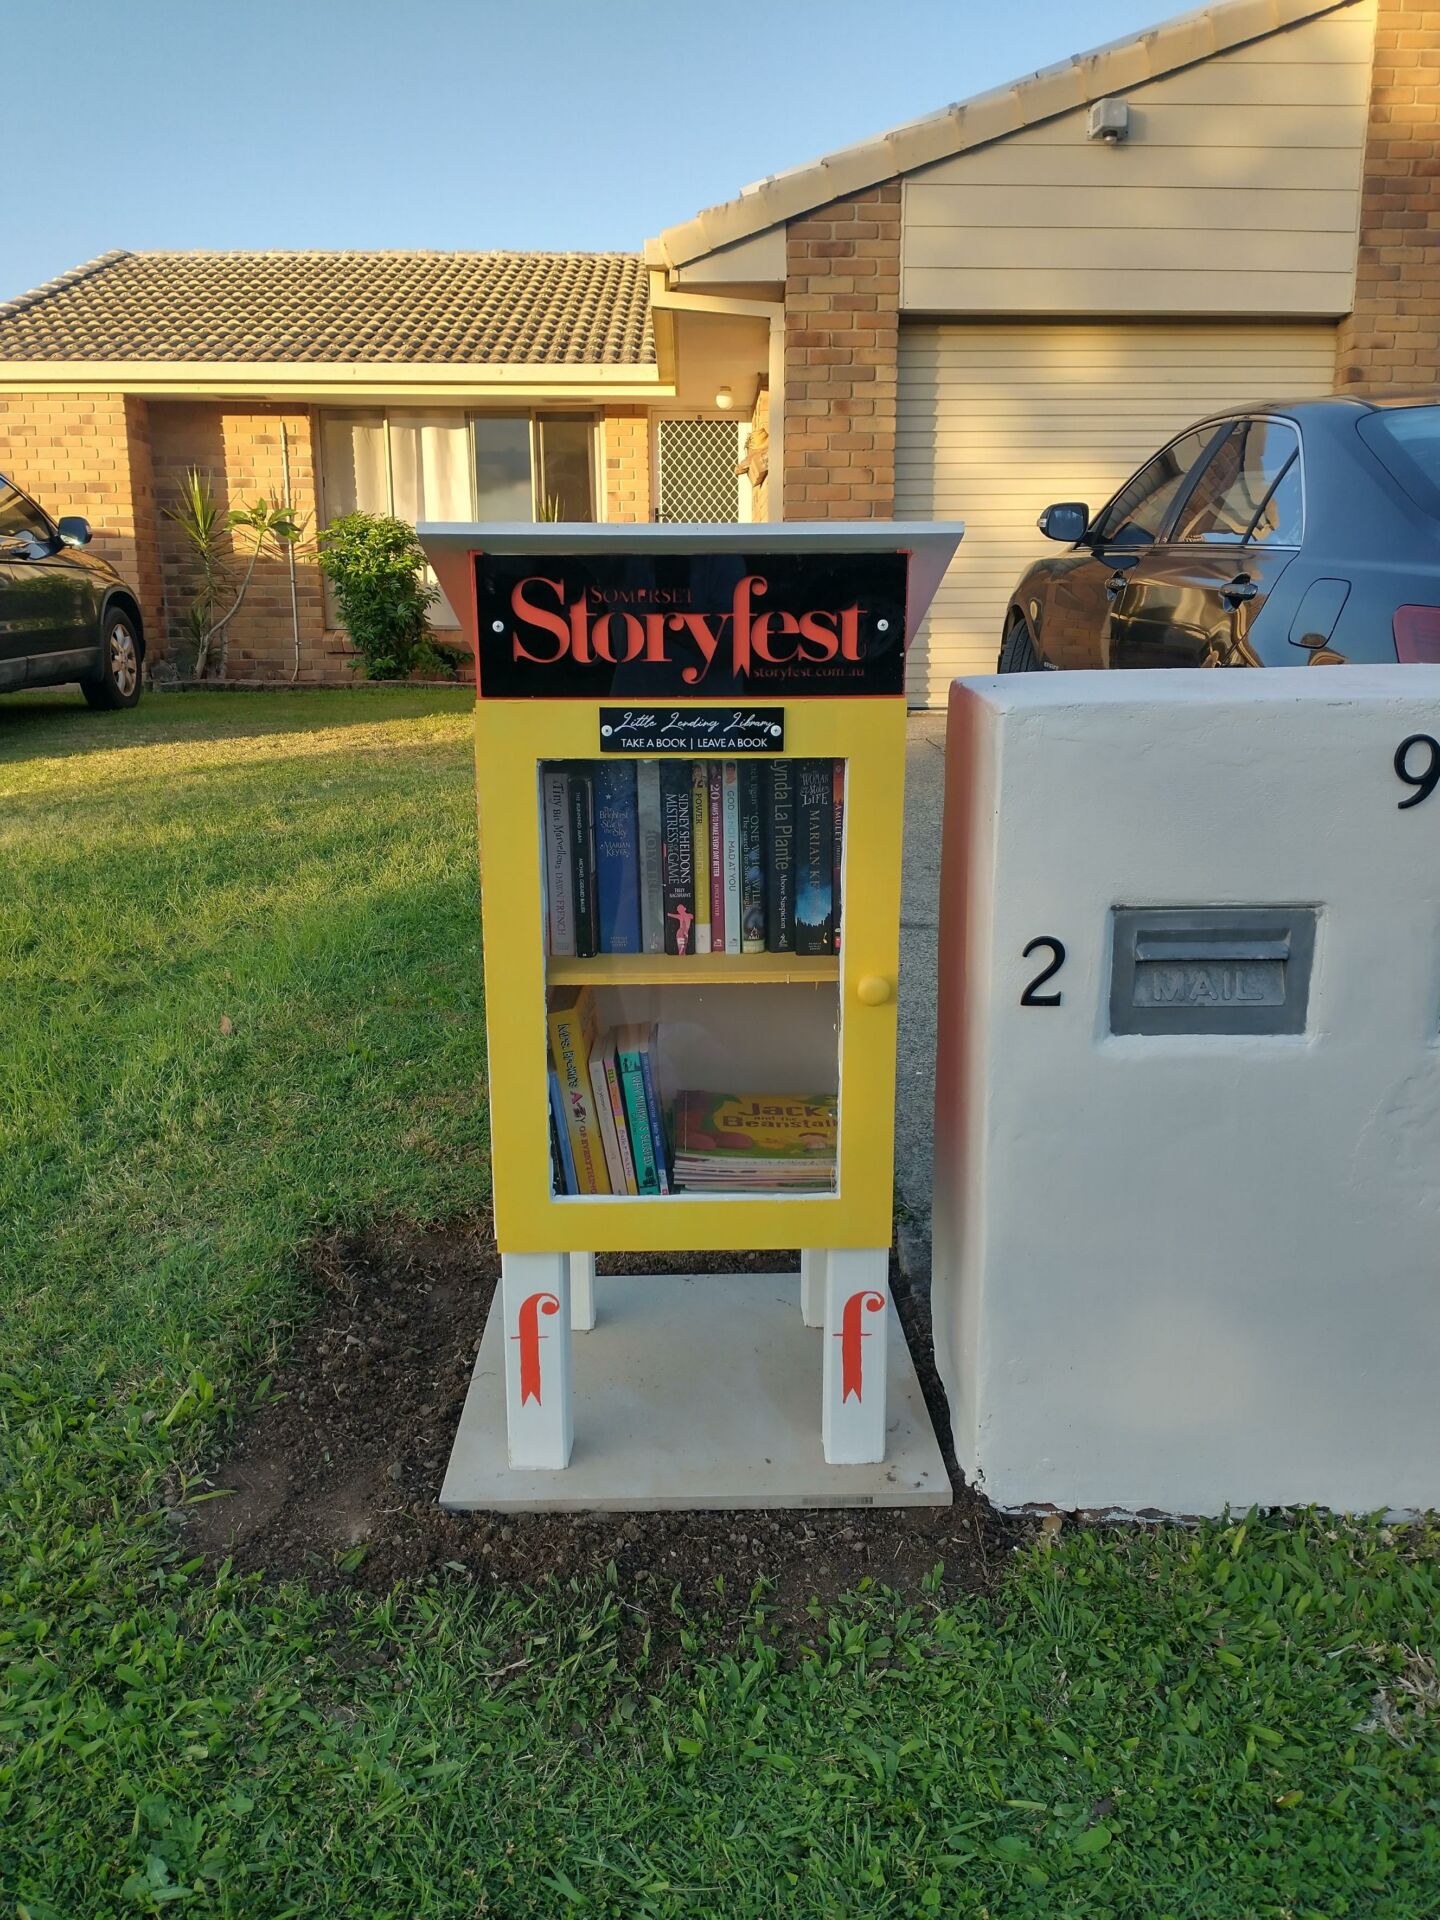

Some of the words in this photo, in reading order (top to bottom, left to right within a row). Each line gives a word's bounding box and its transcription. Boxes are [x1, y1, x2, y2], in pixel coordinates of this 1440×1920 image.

[590, 585, 695, 604] SOMERSET
[511, 576, 868, 684] Storyfest
[614, 712, 657, 732] Little
[661, 712, 719, 732] Lending
[723, 712, 775, 732] Library
[621, 738, 645, 748] TAKE
[647, 738, 654, 748] A
[657, 738, 687, 748] BOOK
[698, 738, 725, 748] LEAVE
[728, 738, 736, 748] A
[738, 738, 767, 748] BOOK
[770, 759, 792, 800] Lynda
[1394, 734, 1440, 809] 9
[551, 783, 564, 808] Tiny
[710, 784, 721, 800] 20
[727, 791, 735, 811] GOD
[666, 793, 679, 844] MISTRESS
[678, 793, 690, 830] SIDNEY
[695, 793, 703, 825] POWER
[774, 804, 792, 822] La
[834, 803, 842, 842] AMULET
[728, 841, 736, 859] MAD
[774, 825, 793, 870] Plante
[809, 809, 820, 865] MARIAN
[667, 853, 679, 884] GAME
[679, 831, 692, 884] SHELDON'S
[729, 861, 737, 872] AT
[554, 871, 565, 897] DAWN
[729, 875, 737, 892] YOU
[779, 873, 787, 895] Above
[555, 898, 566, 937] FRENCH
[778, 896, 787, 929] Suspicion
[1020, 936, 1066, 1006] 2
[1152, 968, 1265, 1002] MAIL
[738, 1102, 823, 1117] Jack
